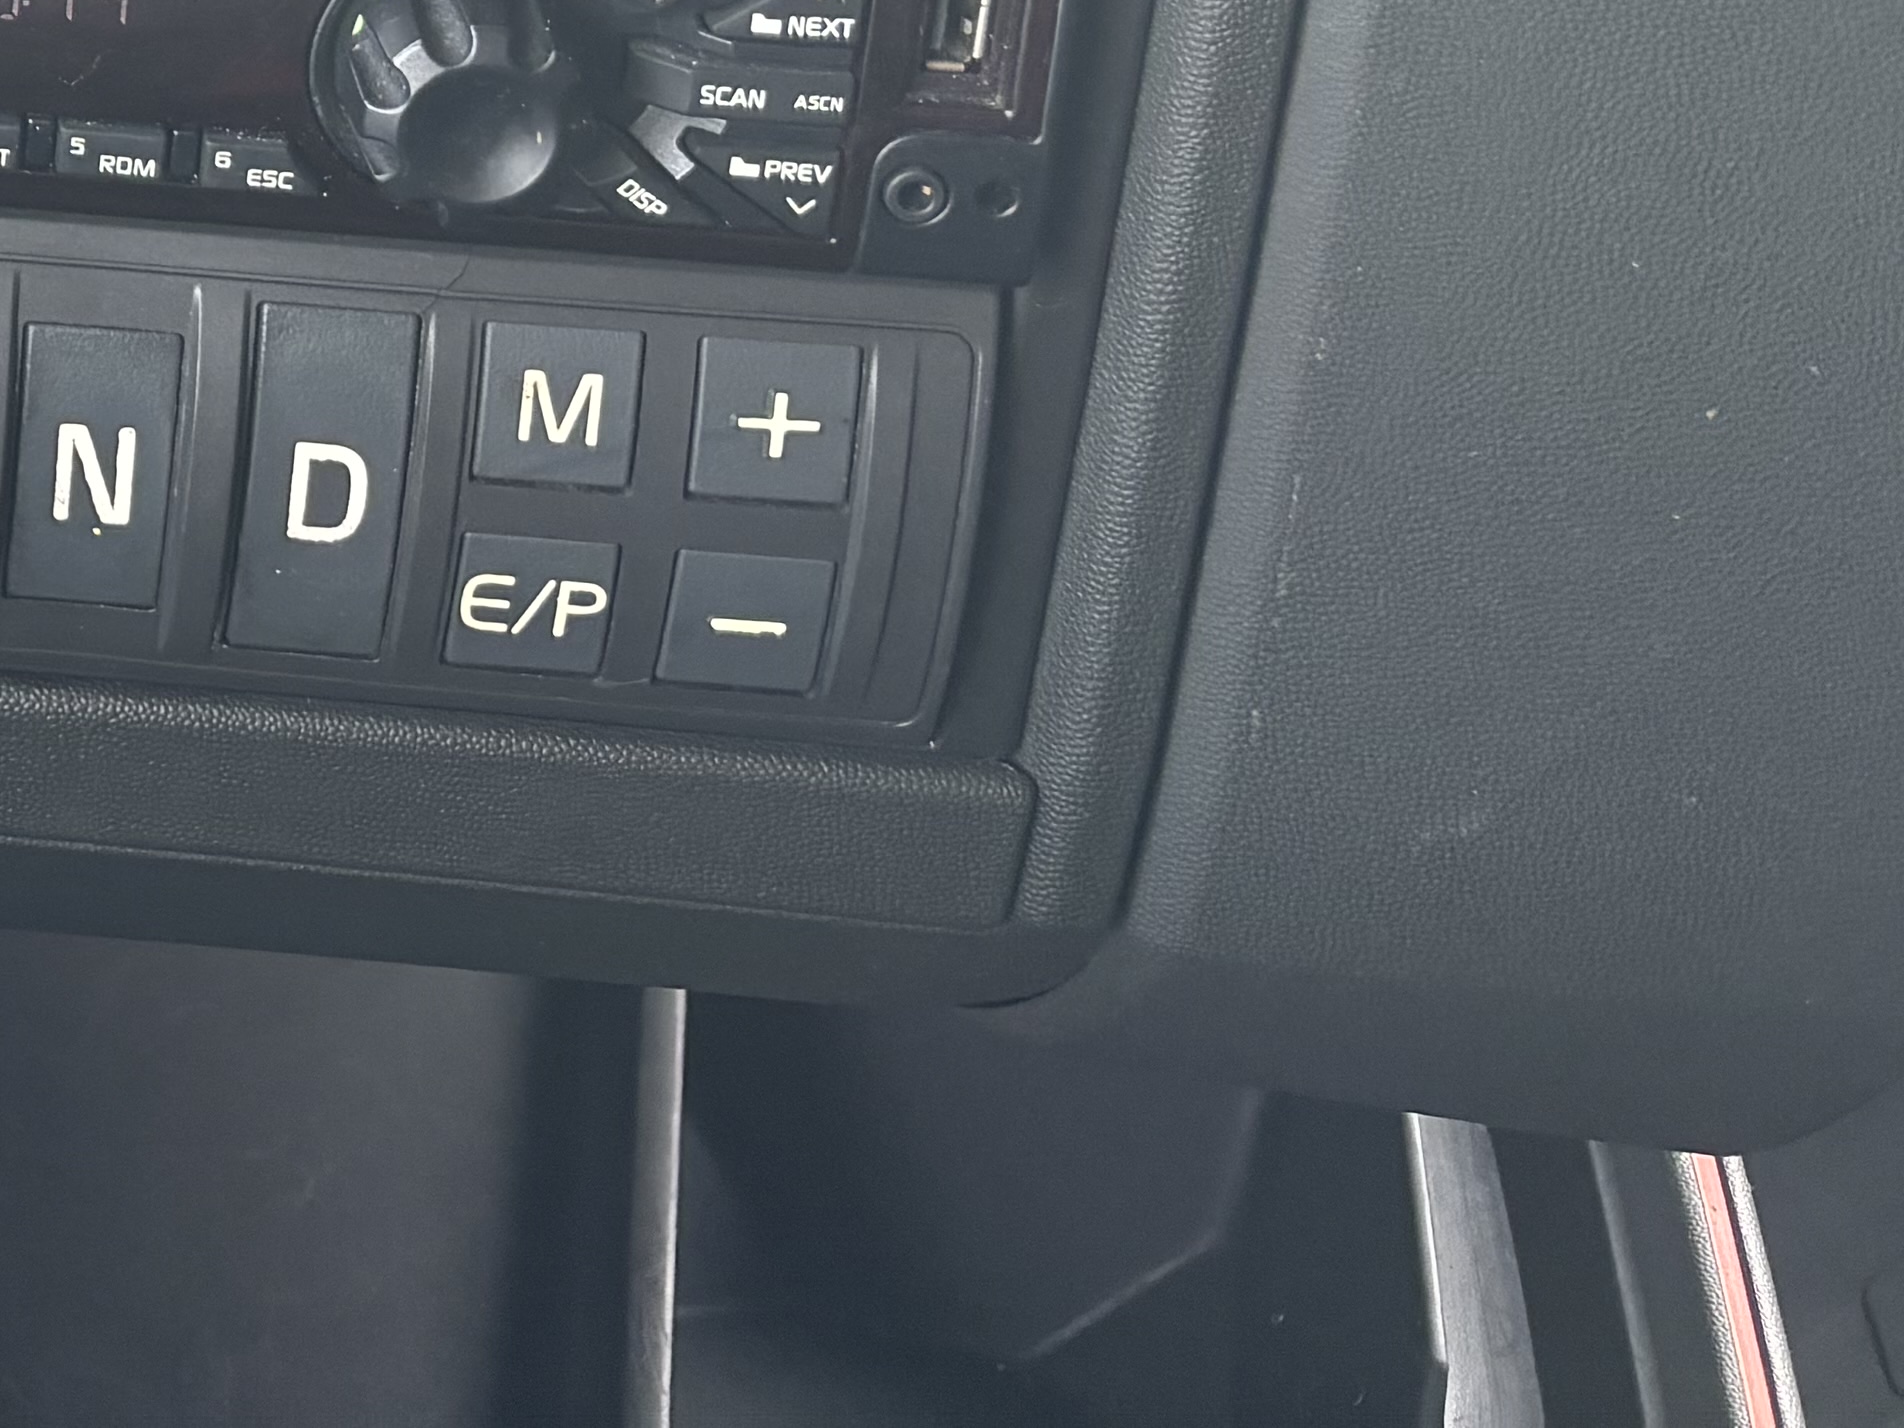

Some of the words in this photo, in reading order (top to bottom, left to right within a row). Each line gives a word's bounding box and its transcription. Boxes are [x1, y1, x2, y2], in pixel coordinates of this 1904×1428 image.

[787, 15, 855, 39] NEXT
[699, 84, 767, 109] SCAN
[793, 94, 844, 113] ASCN
[69, 136, 87, 157] 5
[98, 154, 158, 179] RDM
[214, 150, 233, 170] 6
[245, 168, 295, 191] ESC
[763, 158, 834, 184] PREV
[615, 178, 669, 216] DISP
[515, 367, 606, 447] M
[52, 421, 137, 525] N
[286, 440, 369, 544] D
[458, 573, 609, 640] E/P
